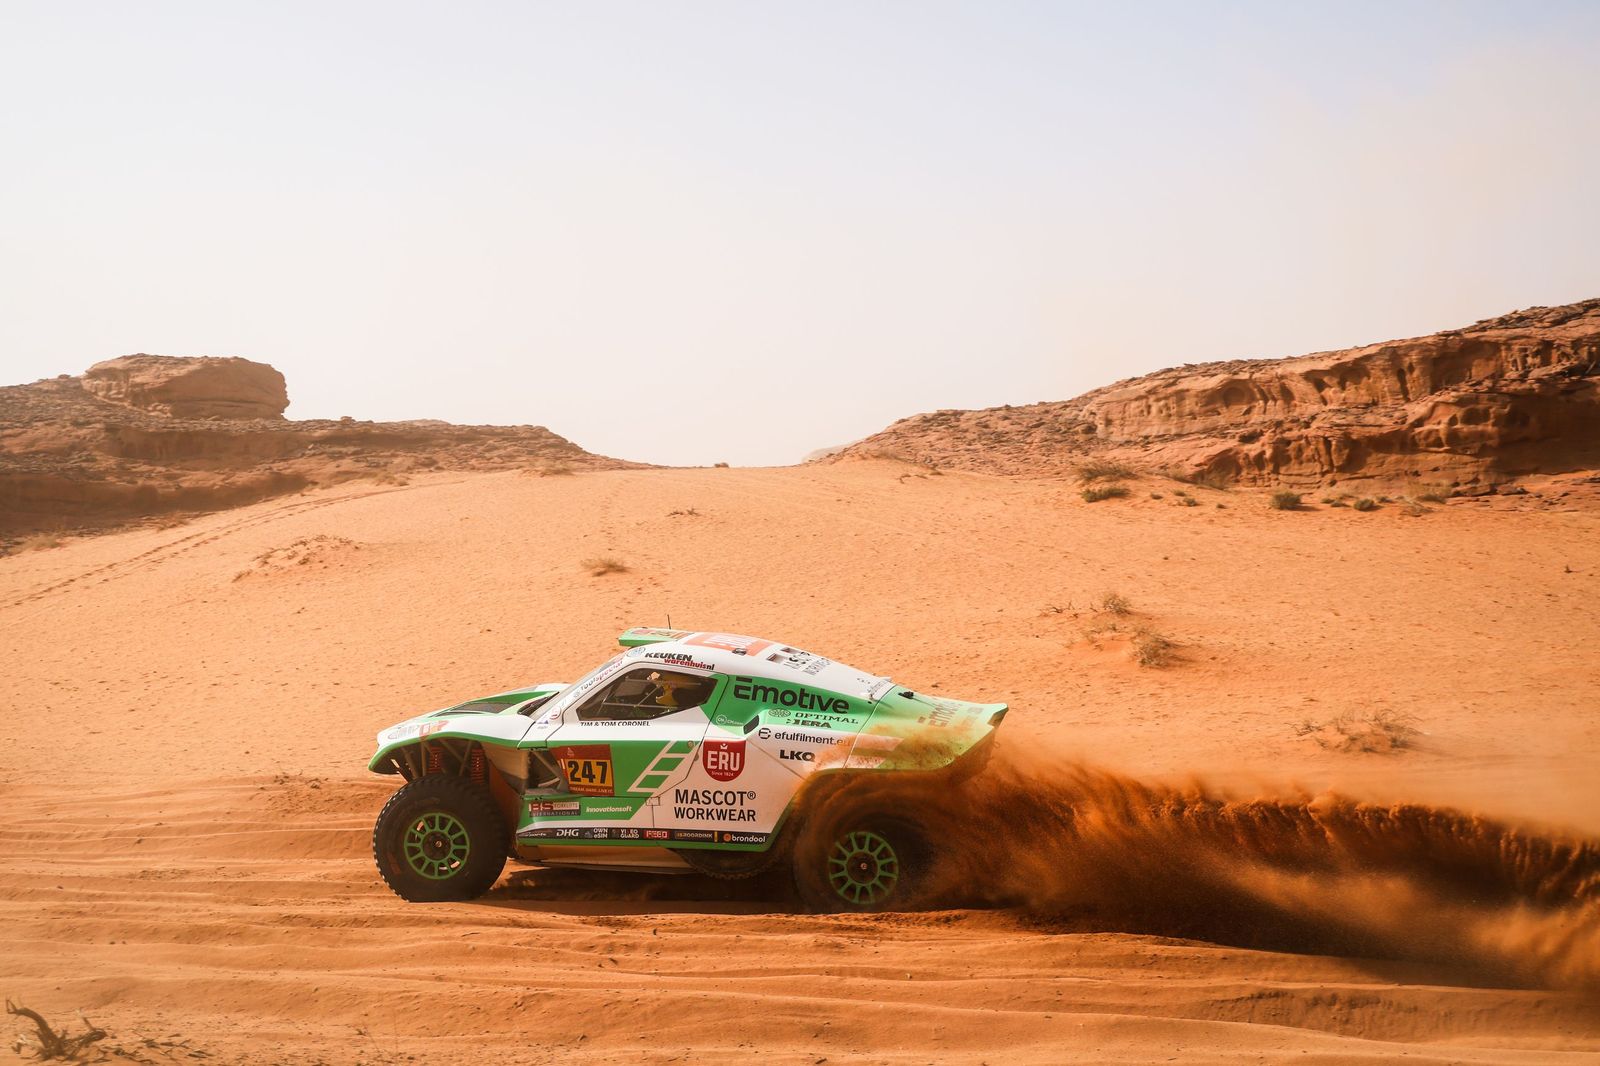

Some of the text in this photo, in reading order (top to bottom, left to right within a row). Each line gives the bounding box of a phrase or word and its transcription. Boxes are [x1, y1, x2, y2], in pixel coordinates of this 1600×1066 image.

[645, 652, 693, 661] KEUKEN
[733, 676, 850, 714] Emotive
[794, 711, 859, 724] OPTIMAL
[707, 750, 740, 772] ERU
[567, 760, 608, 784] 247
[674, 806, 756, 822] WORKWEAR
[556, 828, 579, 837] DHG
